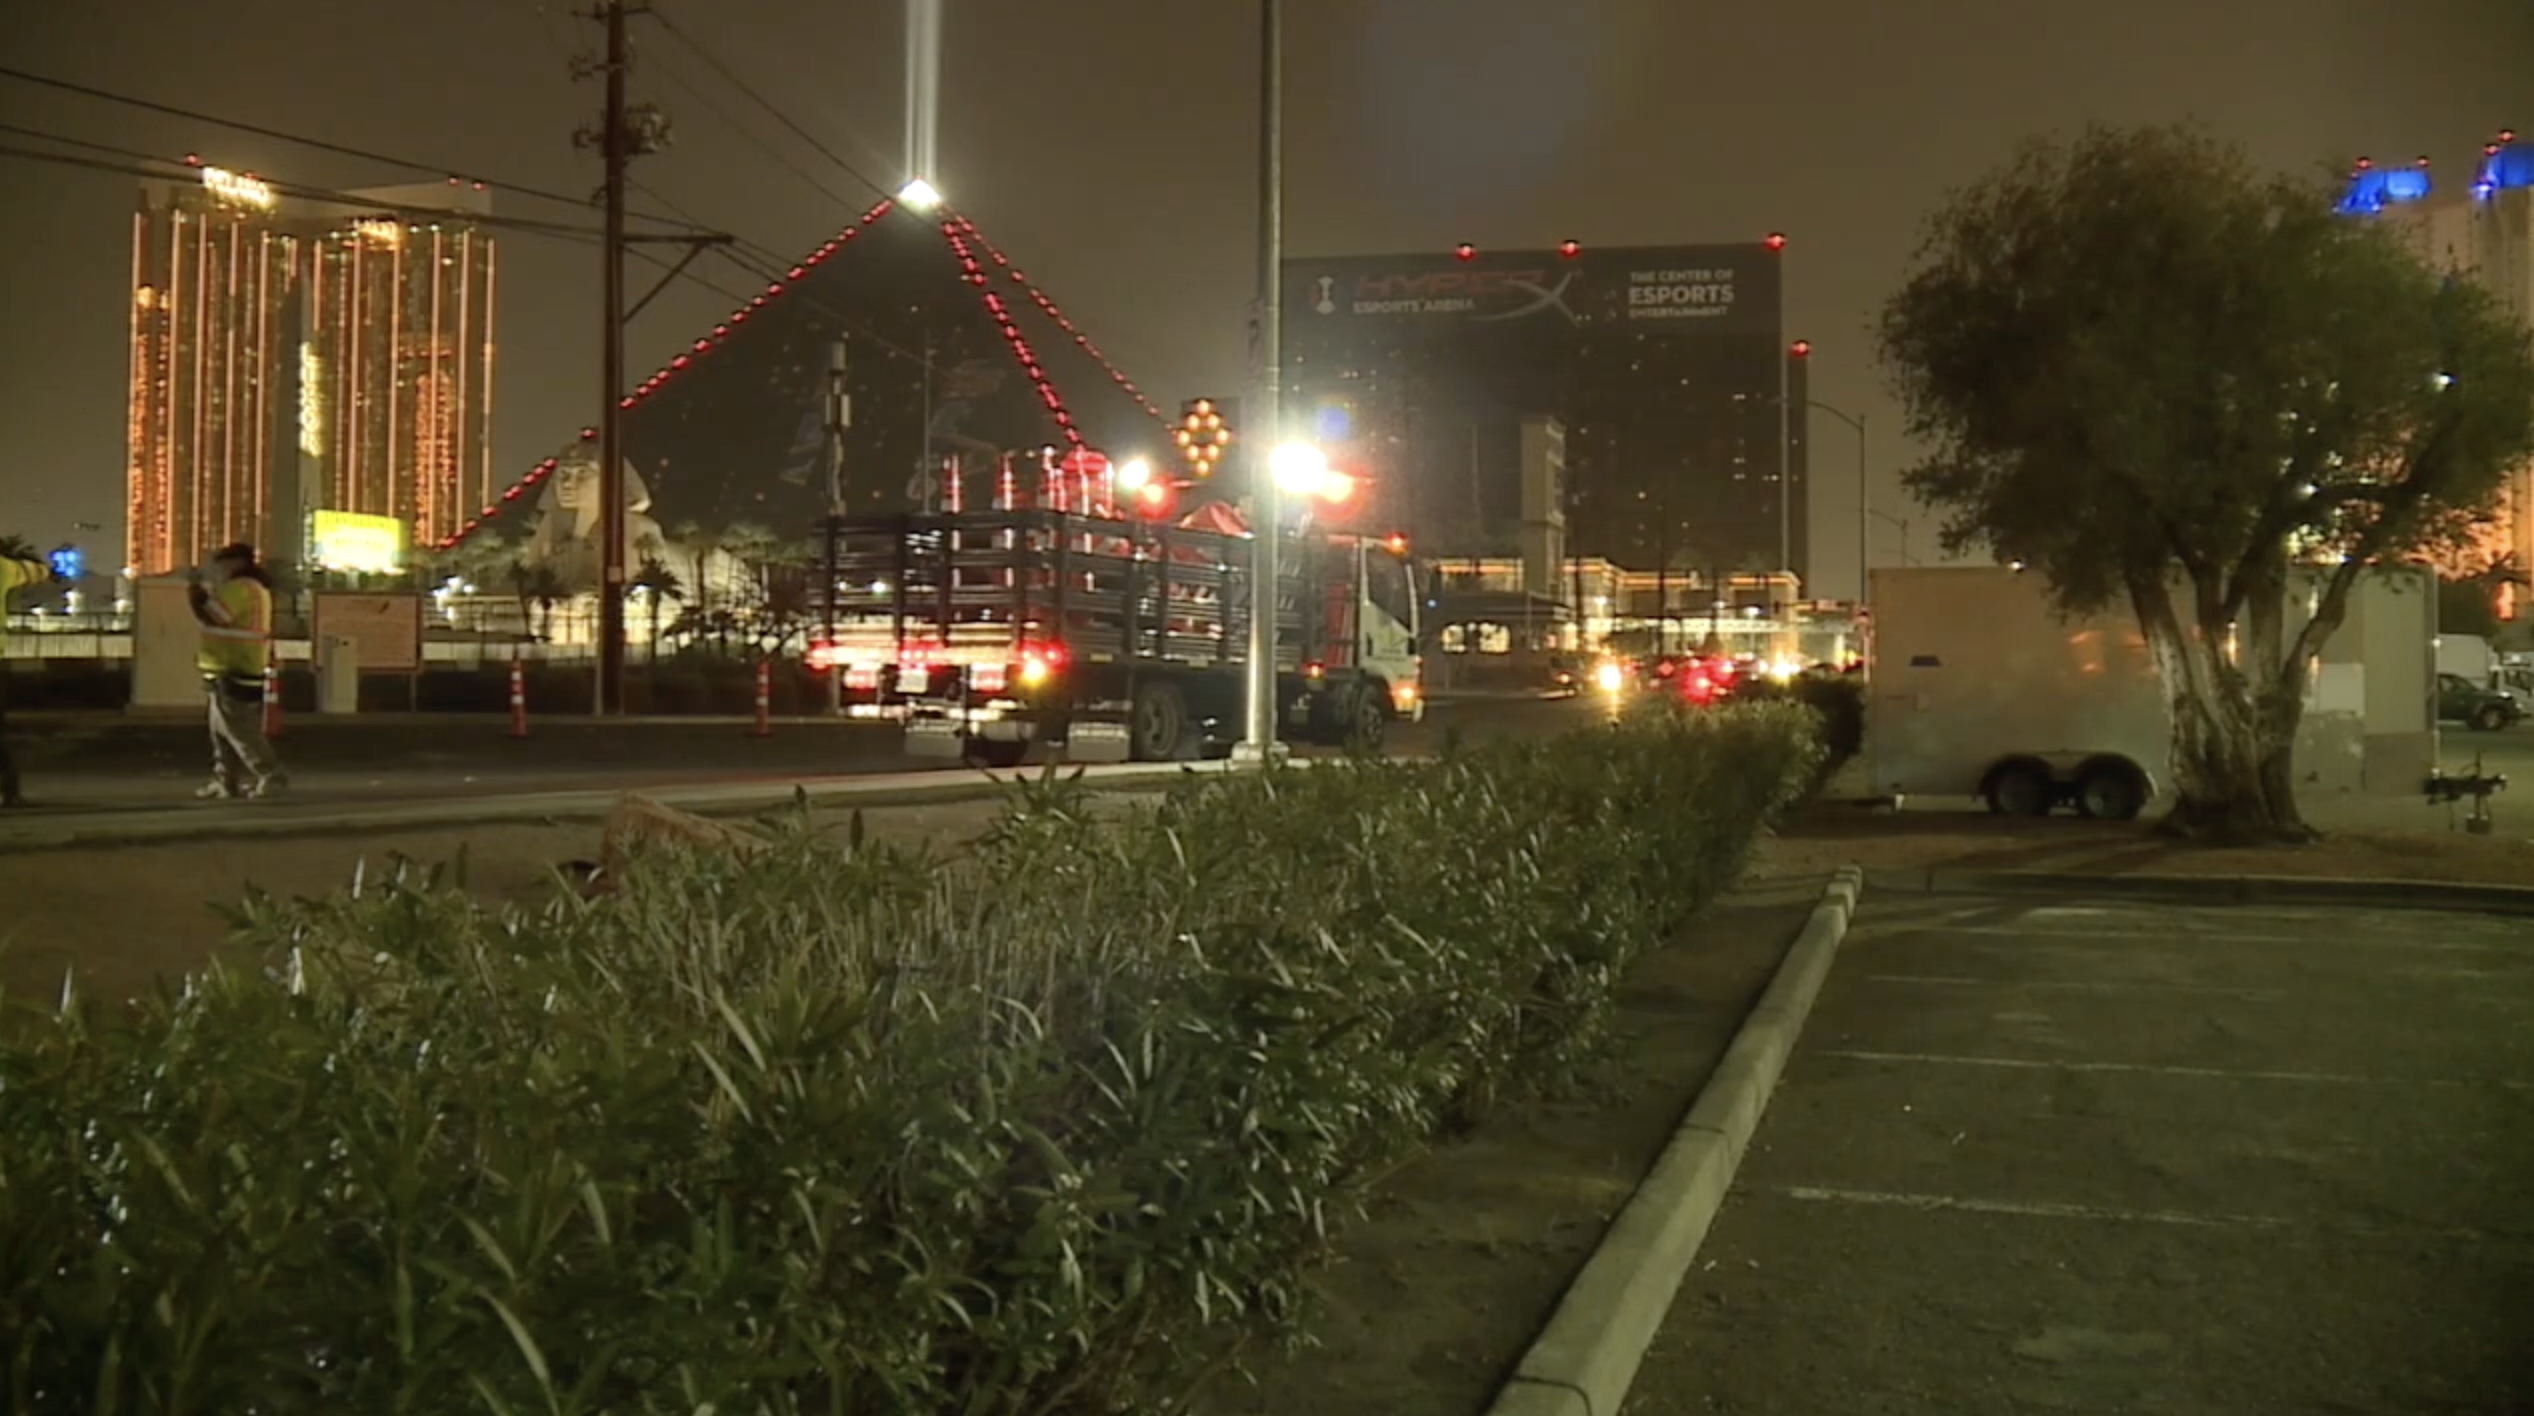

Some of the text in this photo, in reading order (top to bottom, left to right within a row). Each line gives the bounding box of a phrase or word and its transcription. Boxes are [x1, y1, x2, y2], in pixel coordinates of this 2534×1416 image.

[1630, 268, 1734, 283] THE CENTER OF
[1628, 284, 1735, 305] ESPORTS
[1352, 299, 1475, 314] ESPORTS ARENA
